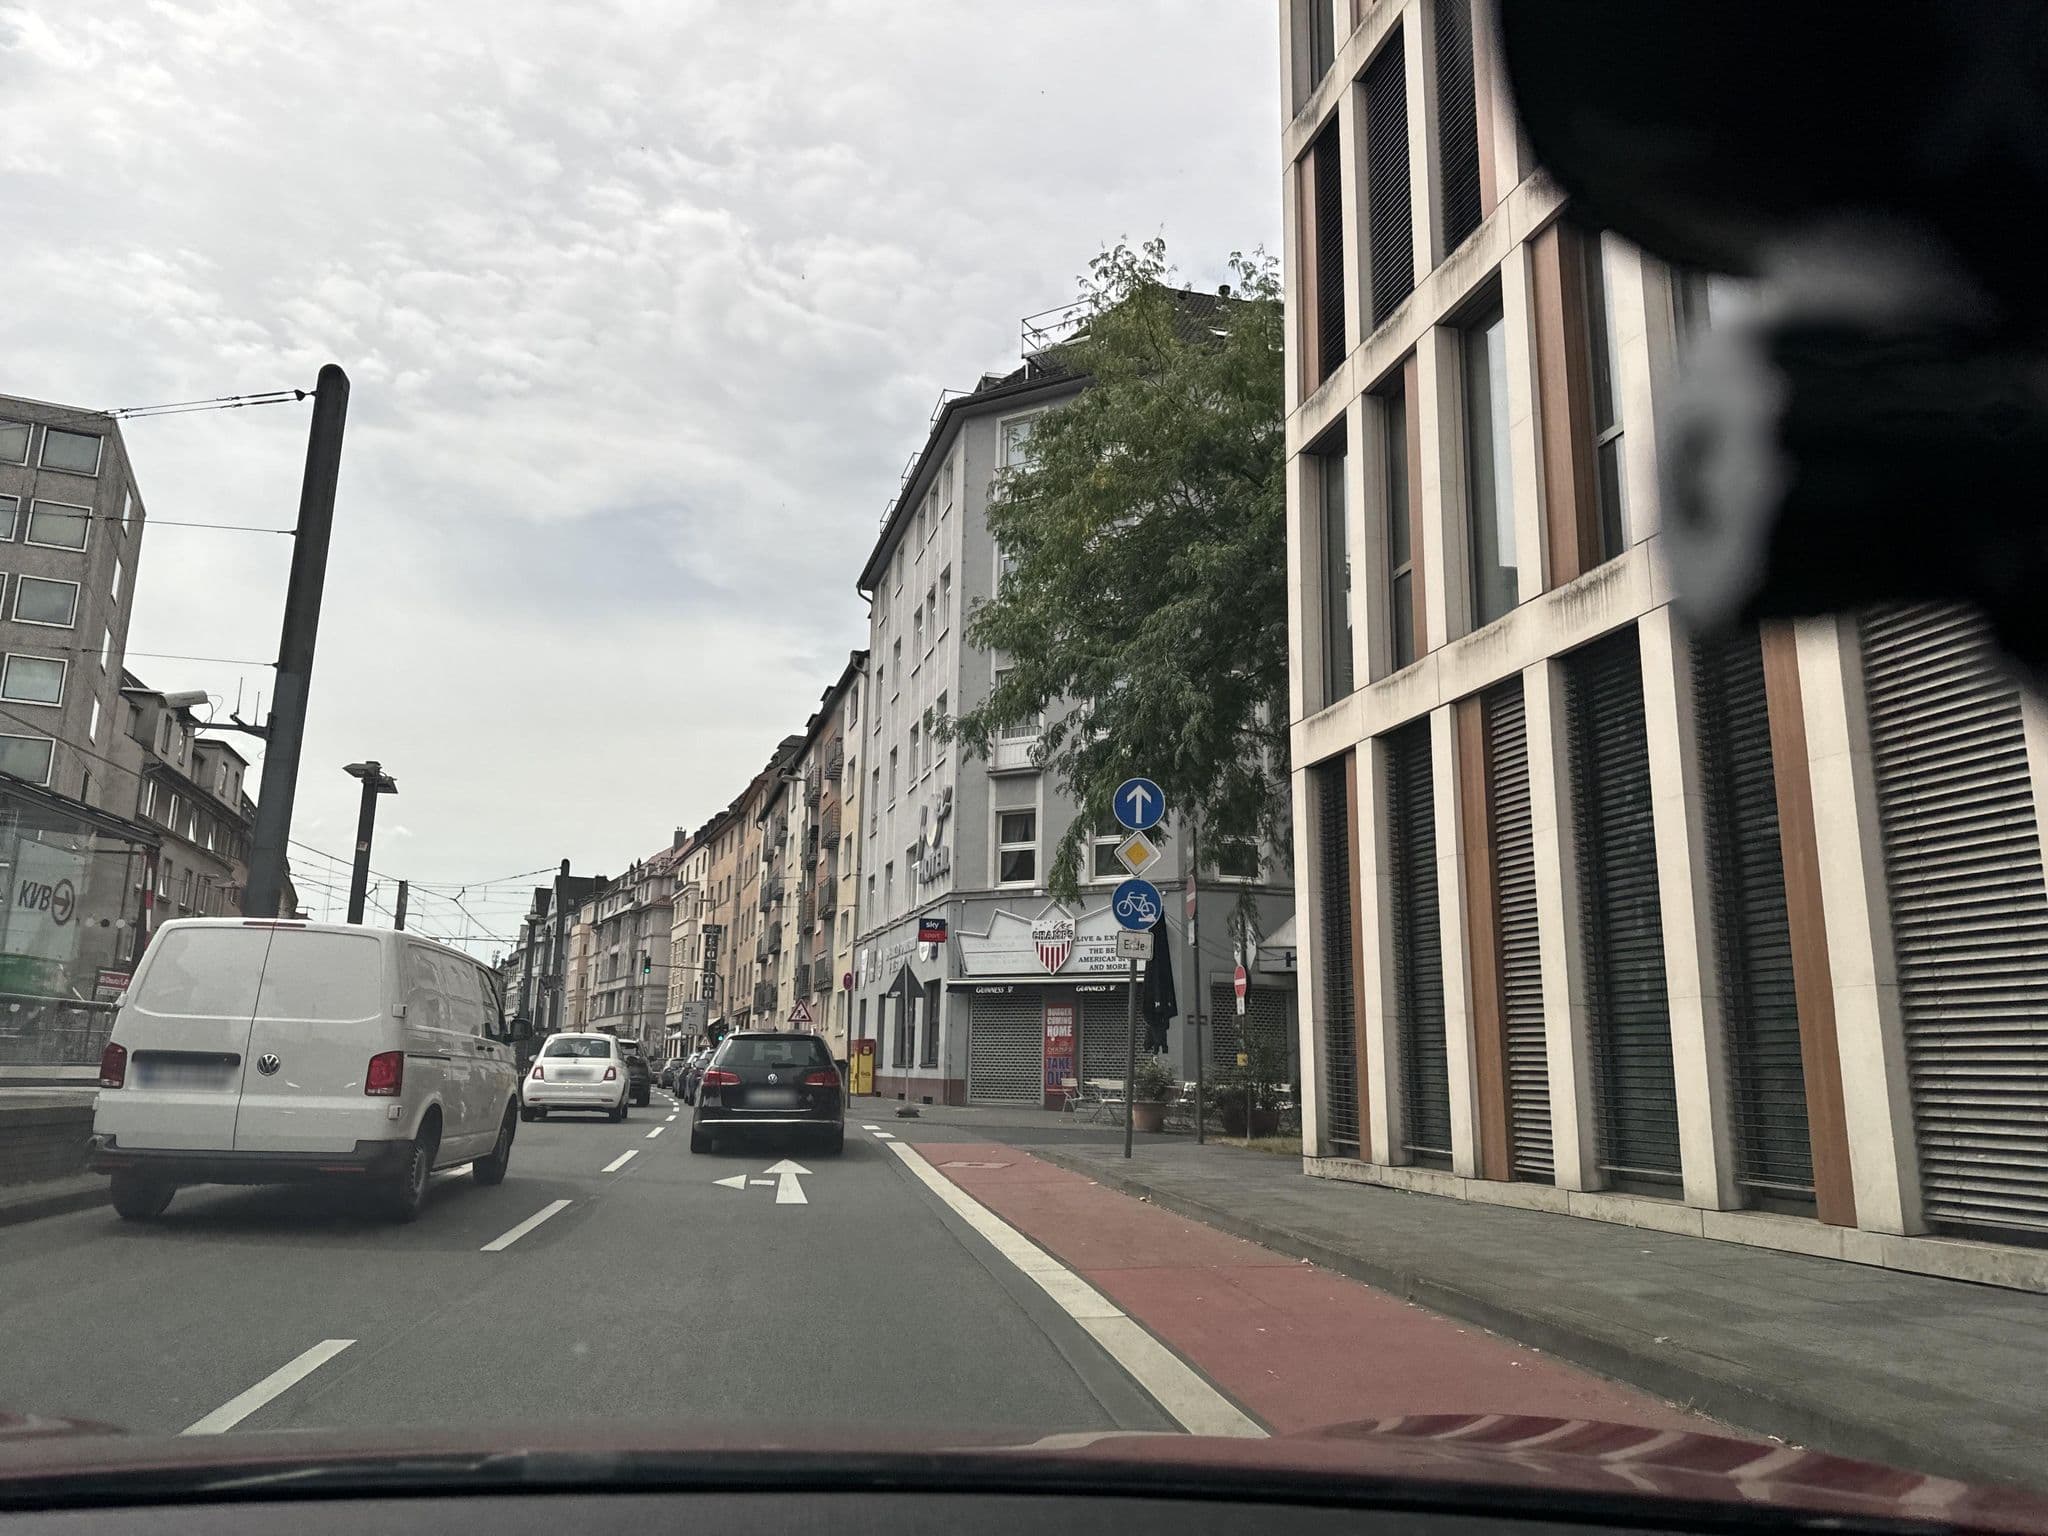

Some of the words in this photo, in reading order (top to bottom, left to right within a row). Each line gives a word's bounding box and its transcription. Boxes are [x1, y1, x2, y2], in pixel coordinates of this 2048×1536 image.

[919, 846, 950, 884] HOTEL
[18, 880, 52, 911] KVB
[925, 920, 940, 930] sky
[1032, 929, 1074, 941] CHAMPS
[1124, 939, 1145, 951] Ede
[1078, 955, 1116, 963] AMERICAN
[975, 986, 1005, 994] GUINNESS
[1047, 1025, 1072, 1037] HOME
[1047, 1057, 1072, 1070] TAKE
